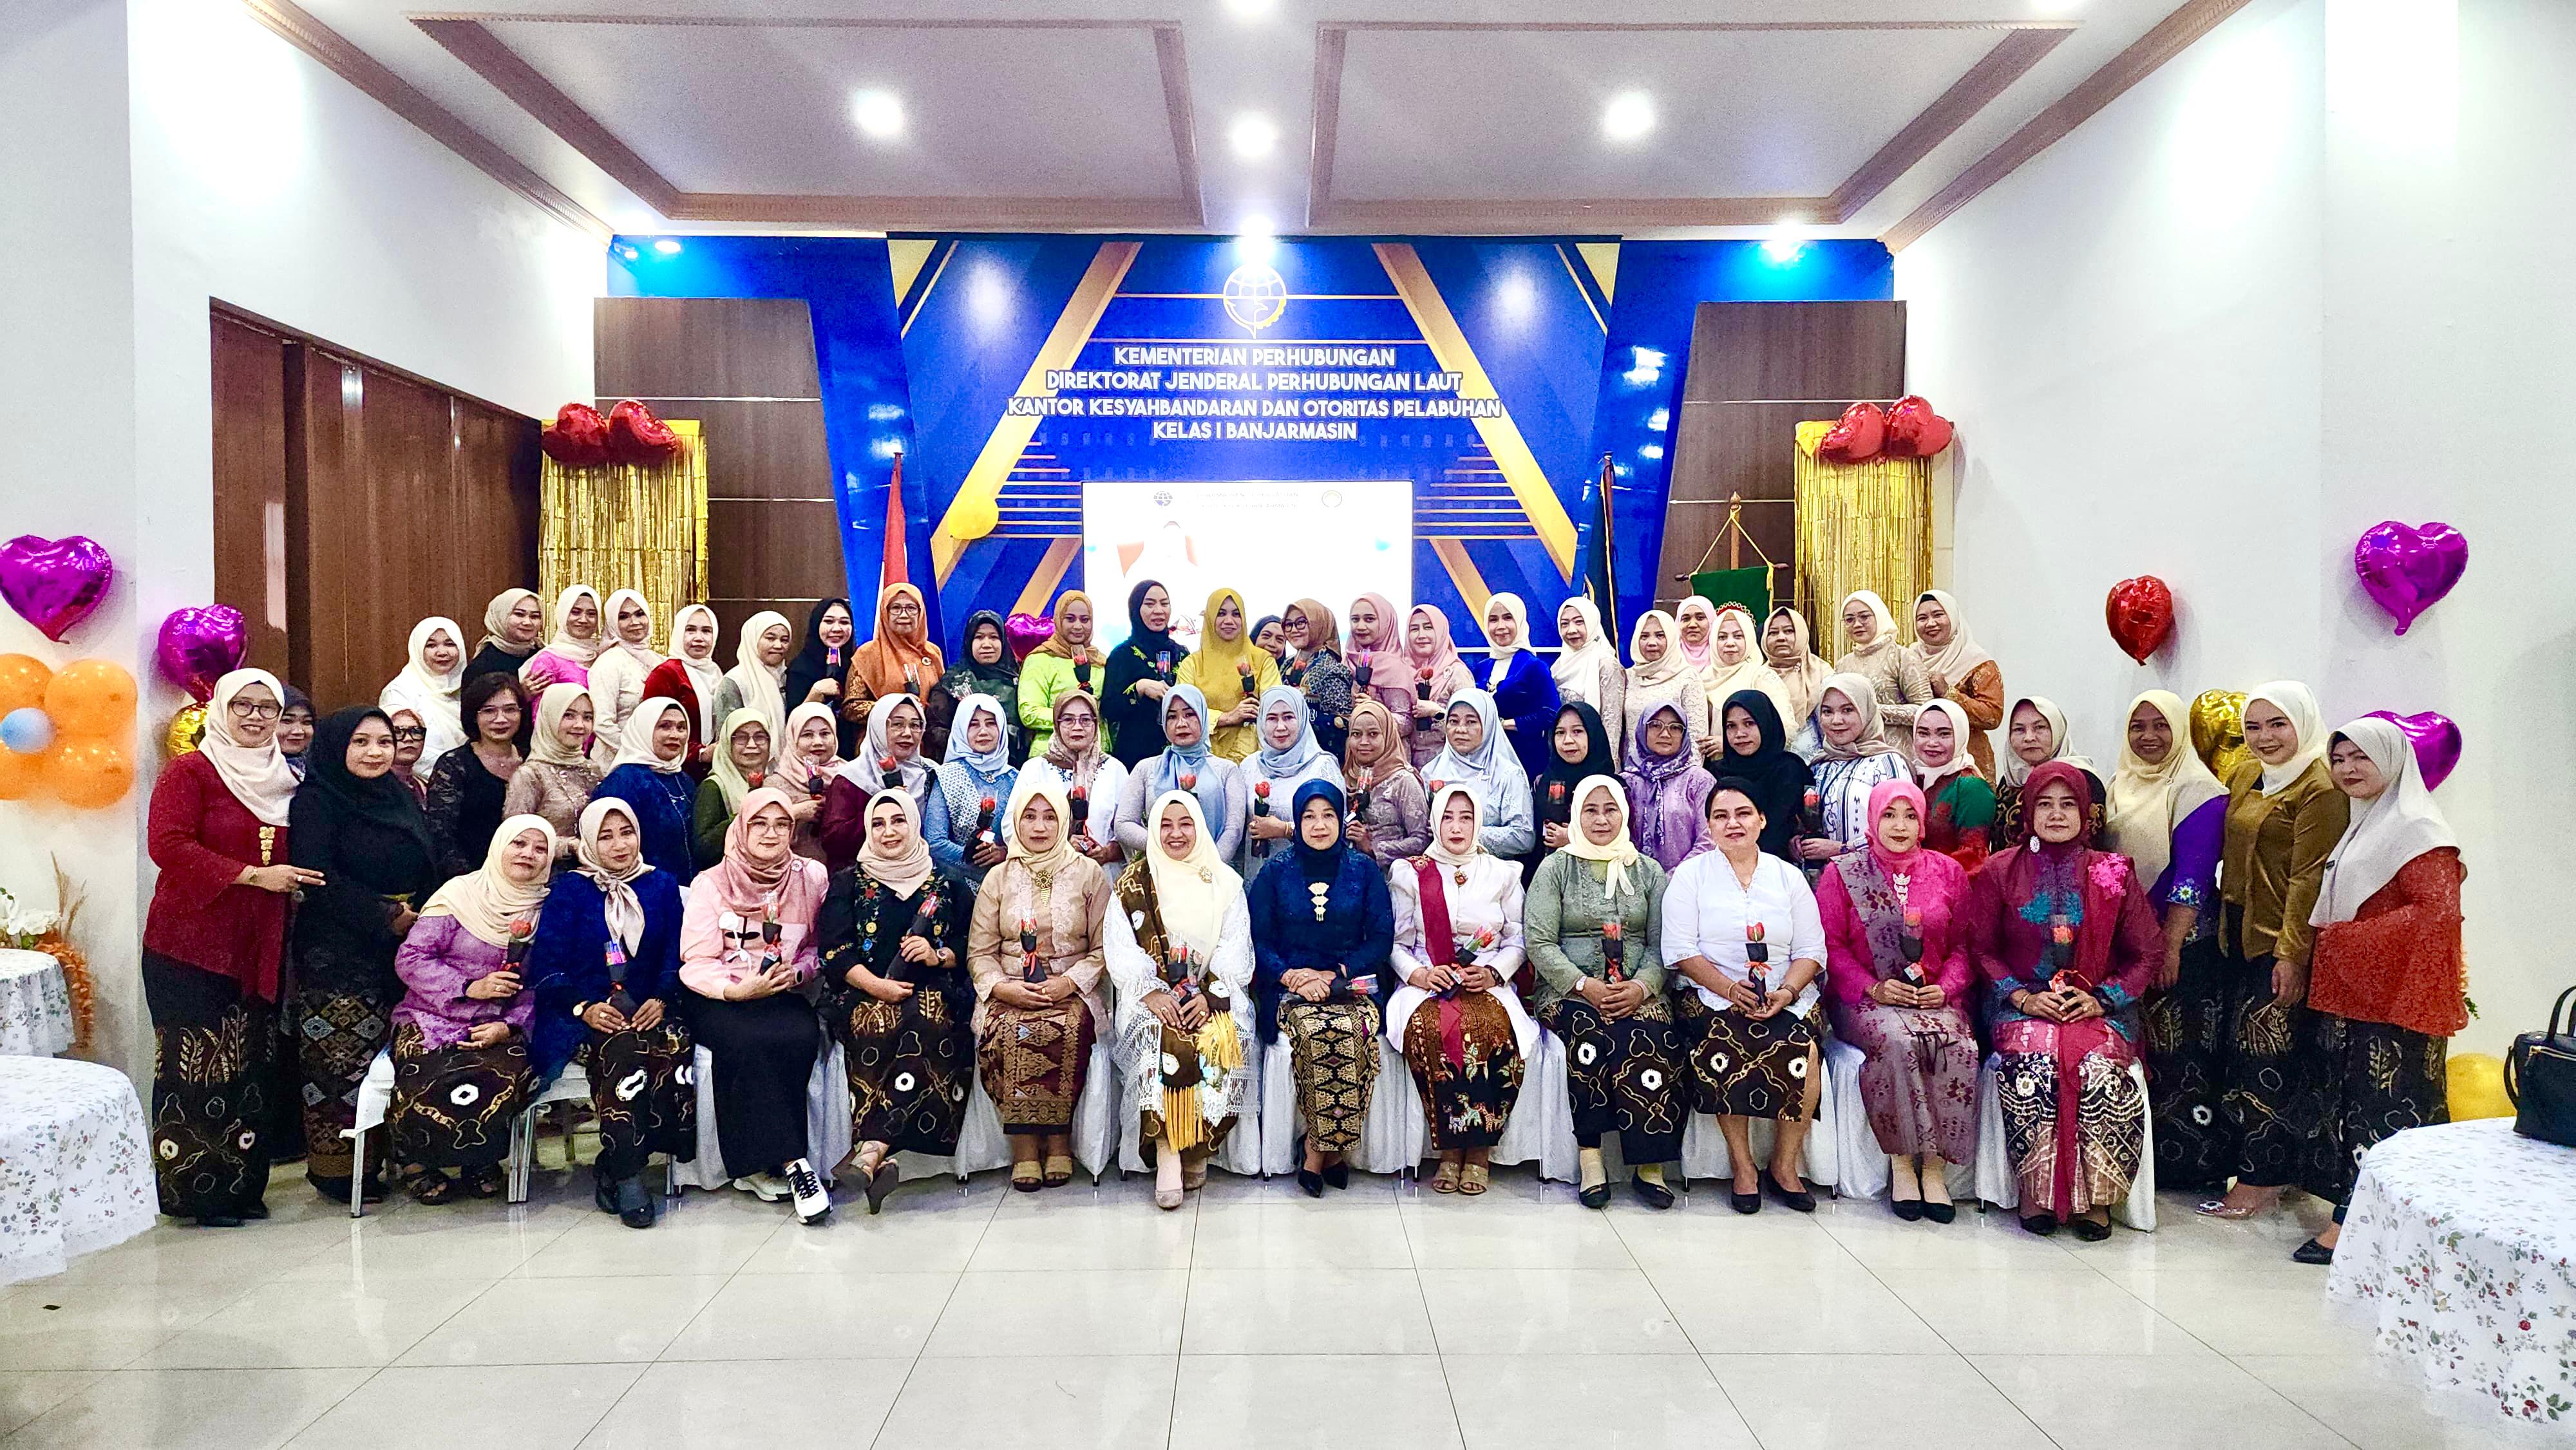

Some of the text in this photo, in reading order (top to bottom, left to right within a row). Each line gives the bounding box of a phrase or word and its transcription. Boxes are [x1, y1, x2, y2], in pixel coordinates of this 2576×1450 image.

[1115, 347, 1395, 366] KEMENTERIAN PERHUBUNGAN
[1047, 371, 1462, 390] DIREKTORAT JENDERAL PERHUBUNGAN LAUT
[1008, 398, 1501, 417] KANTOR KESYAHBANDARAN DAN OTORITAS PELABUHAN
[1153, 422, 1357, 439] KELAS I BANJARMASIN
